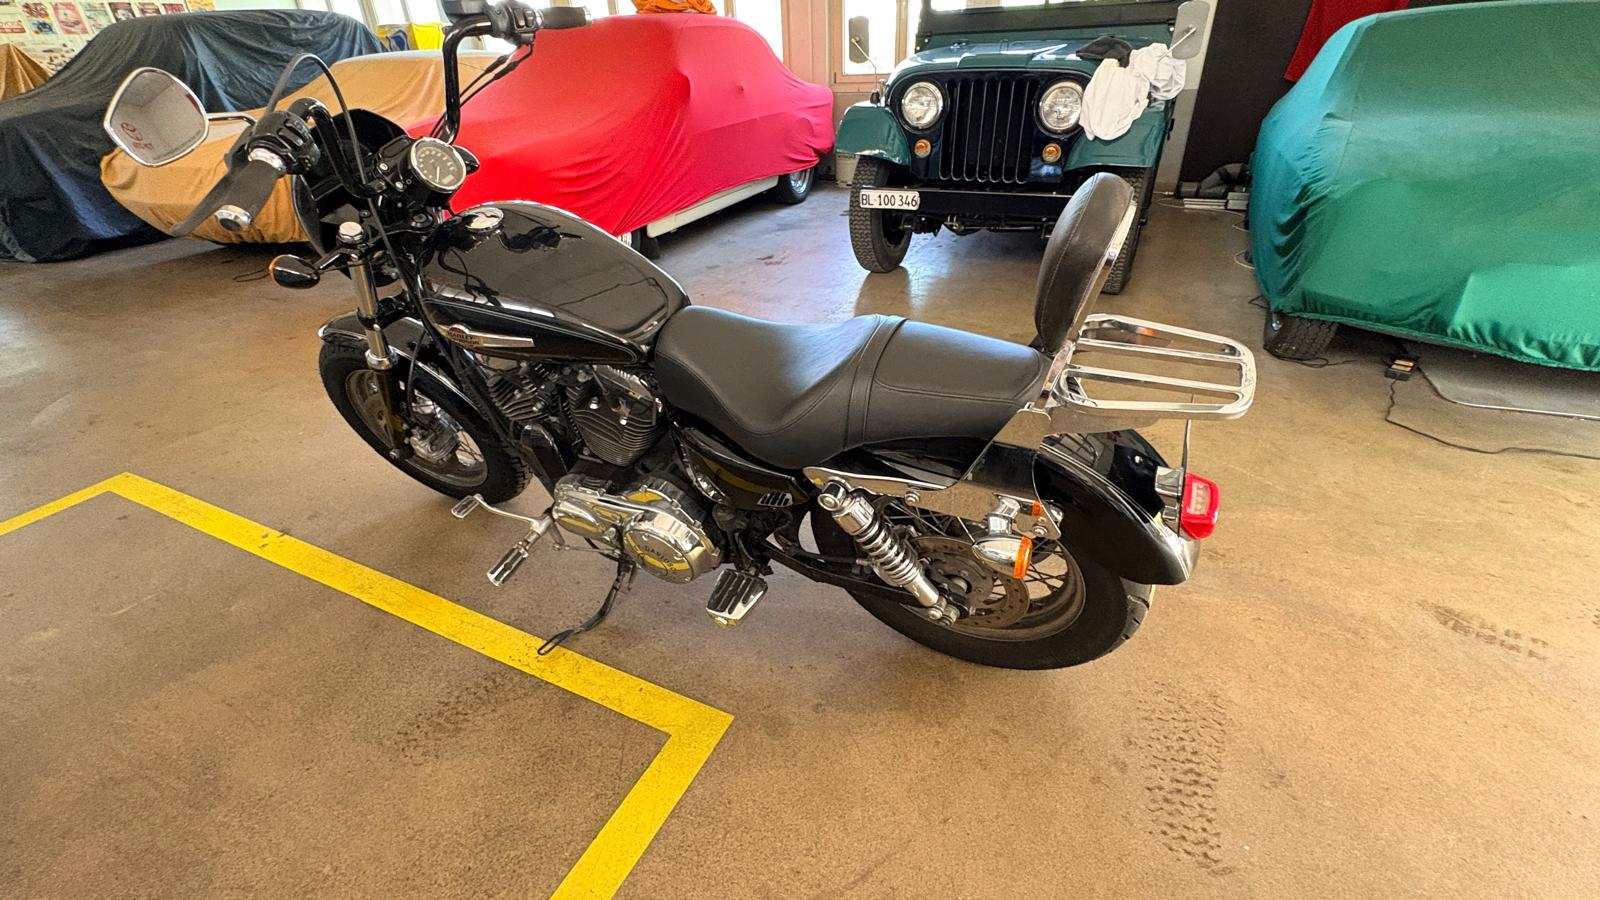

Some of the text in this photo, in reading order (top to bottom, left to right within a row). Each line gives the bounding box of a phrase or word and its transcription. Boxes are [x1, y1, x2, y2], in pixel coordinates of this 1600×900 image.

[861, 194, 918, 207] BL 100 346
